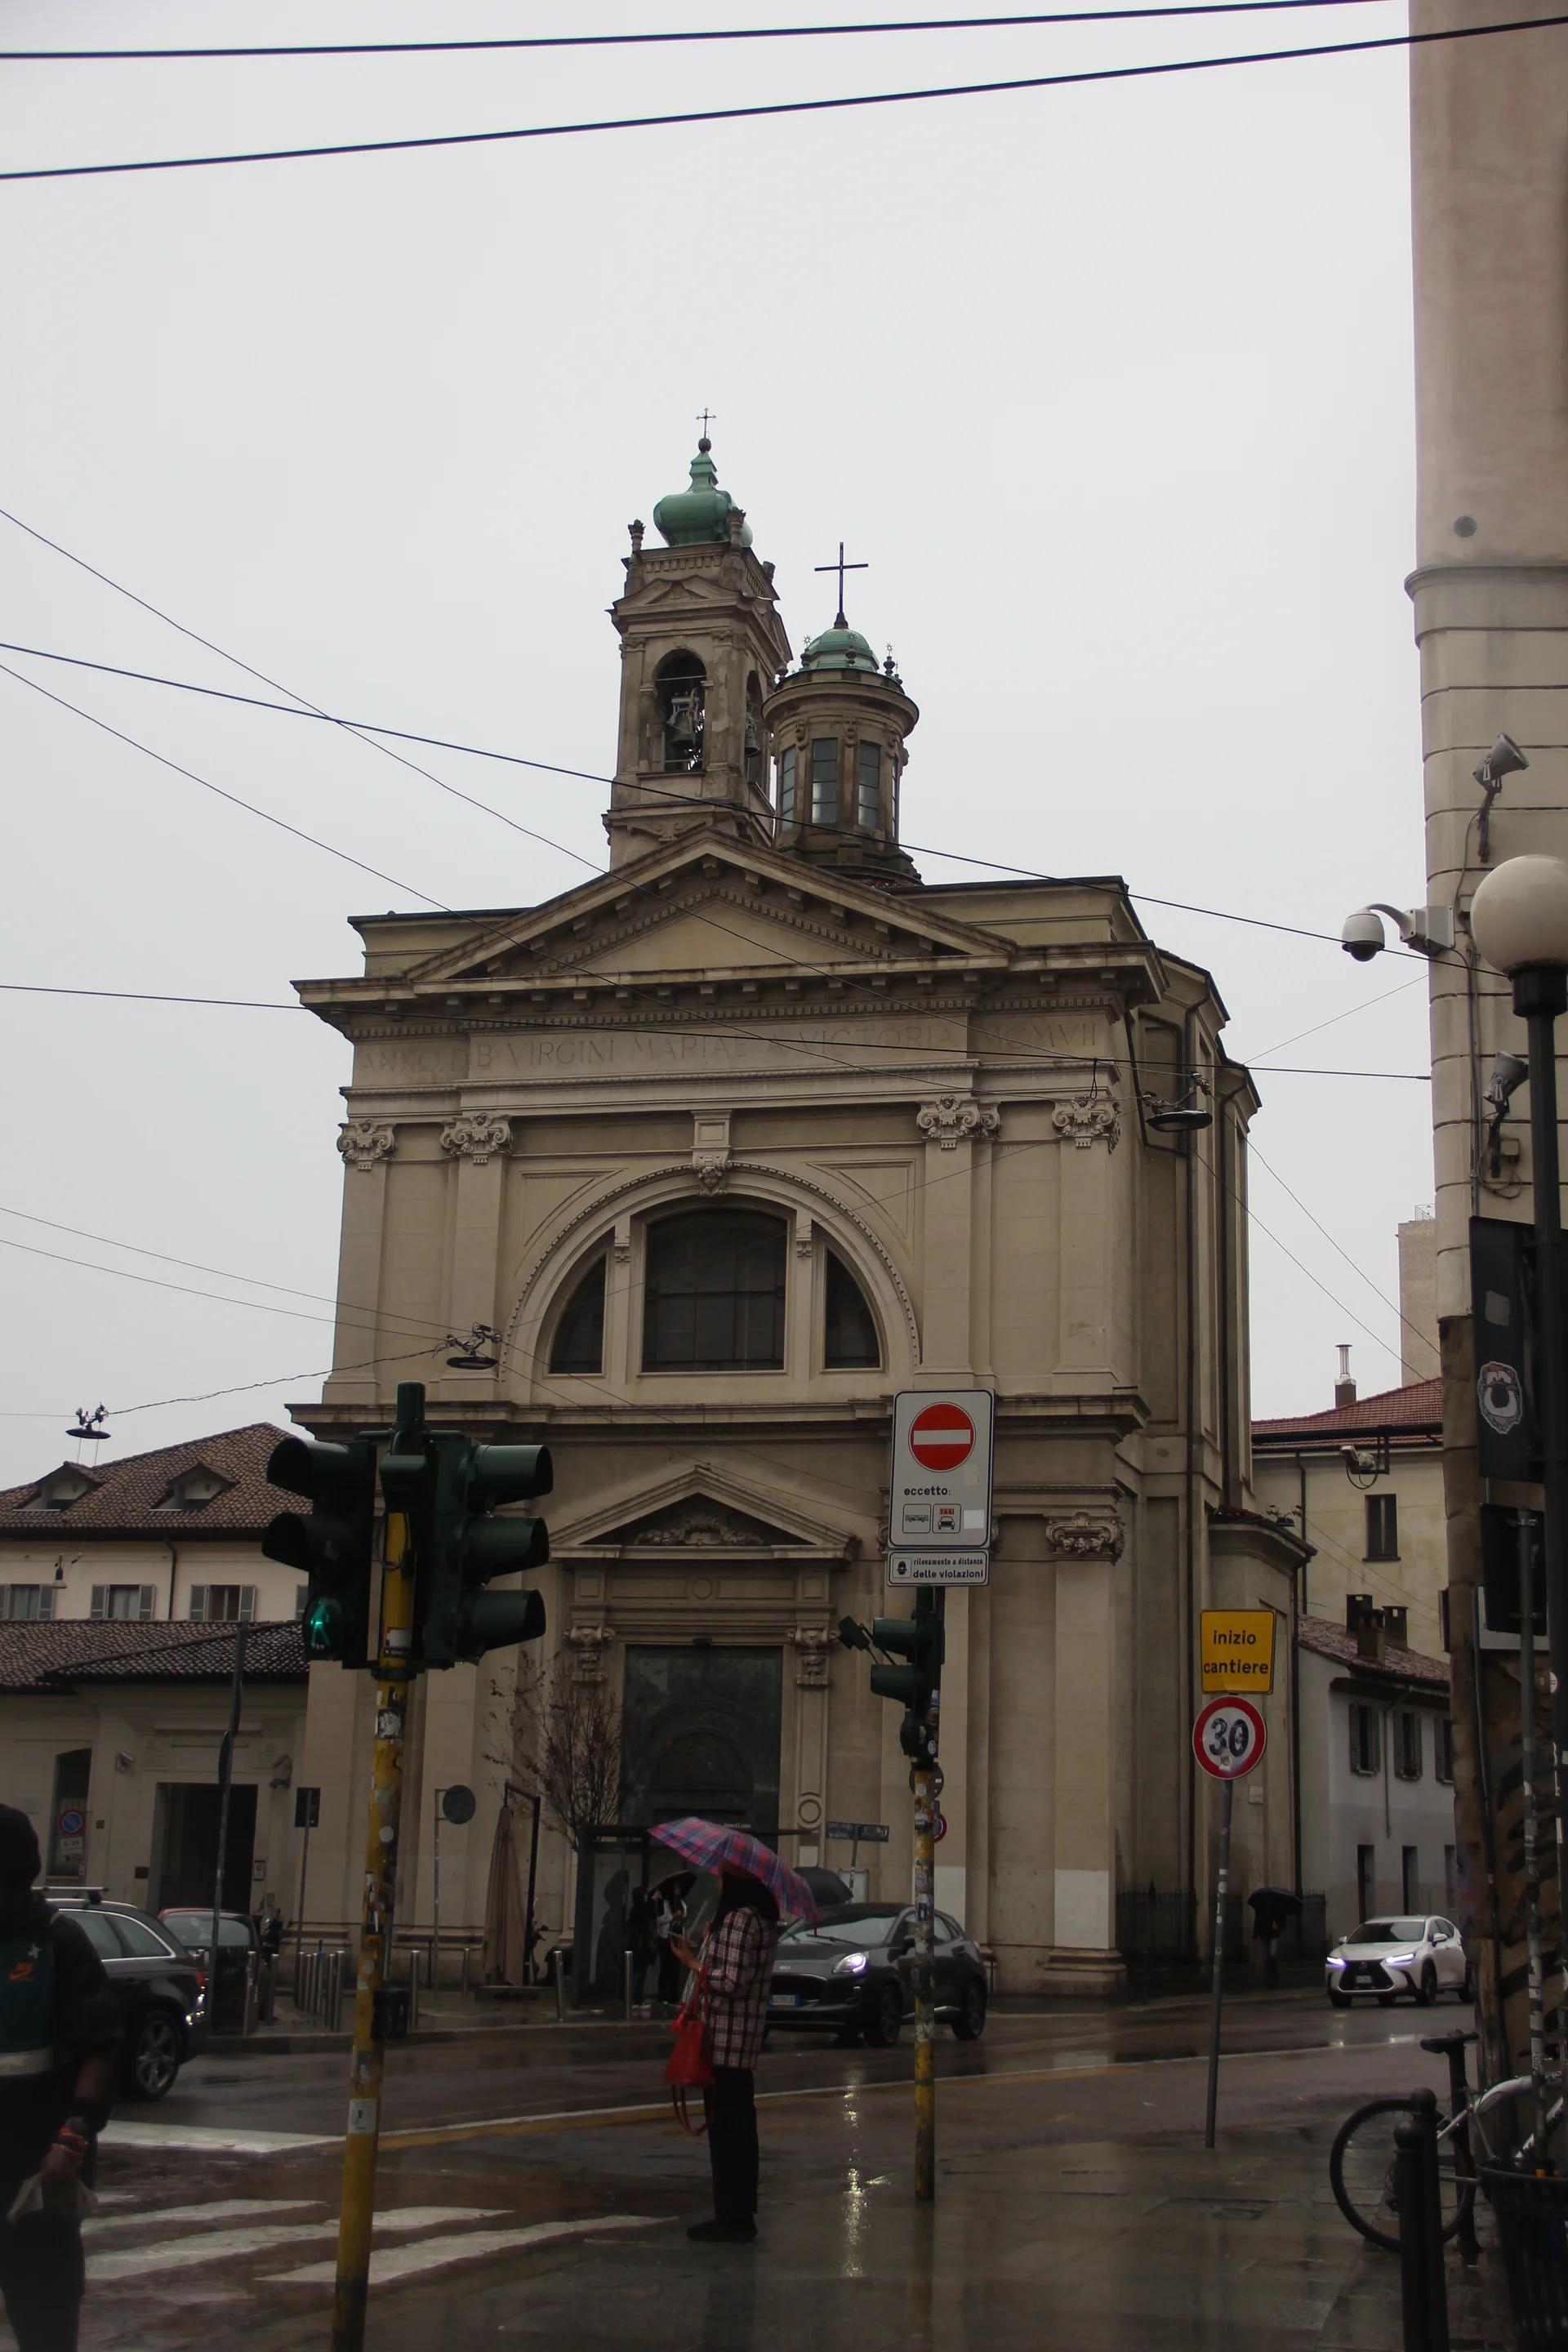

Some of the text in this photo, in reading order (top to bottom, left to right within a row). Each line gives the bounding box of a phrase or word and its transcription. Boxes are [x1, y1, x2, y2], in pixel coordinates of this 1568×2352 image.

[506, 1039, 614, 1068] VIRGINI
[630, 1033, 748, 1060] MARIAE
[799, 1026, 957, 1054] VICTORIA
[913, 1557, 951, 1566] rilevamento
[958, 1557, 983, 1566] distanza
[913, 1569, 983, 1579] delle violazioni
[1213, 1630, 1257, 1645] inizio
[1203, 1659, 1269, 1674] cantiere
[1208, 1717, 1250, 1757] 30
